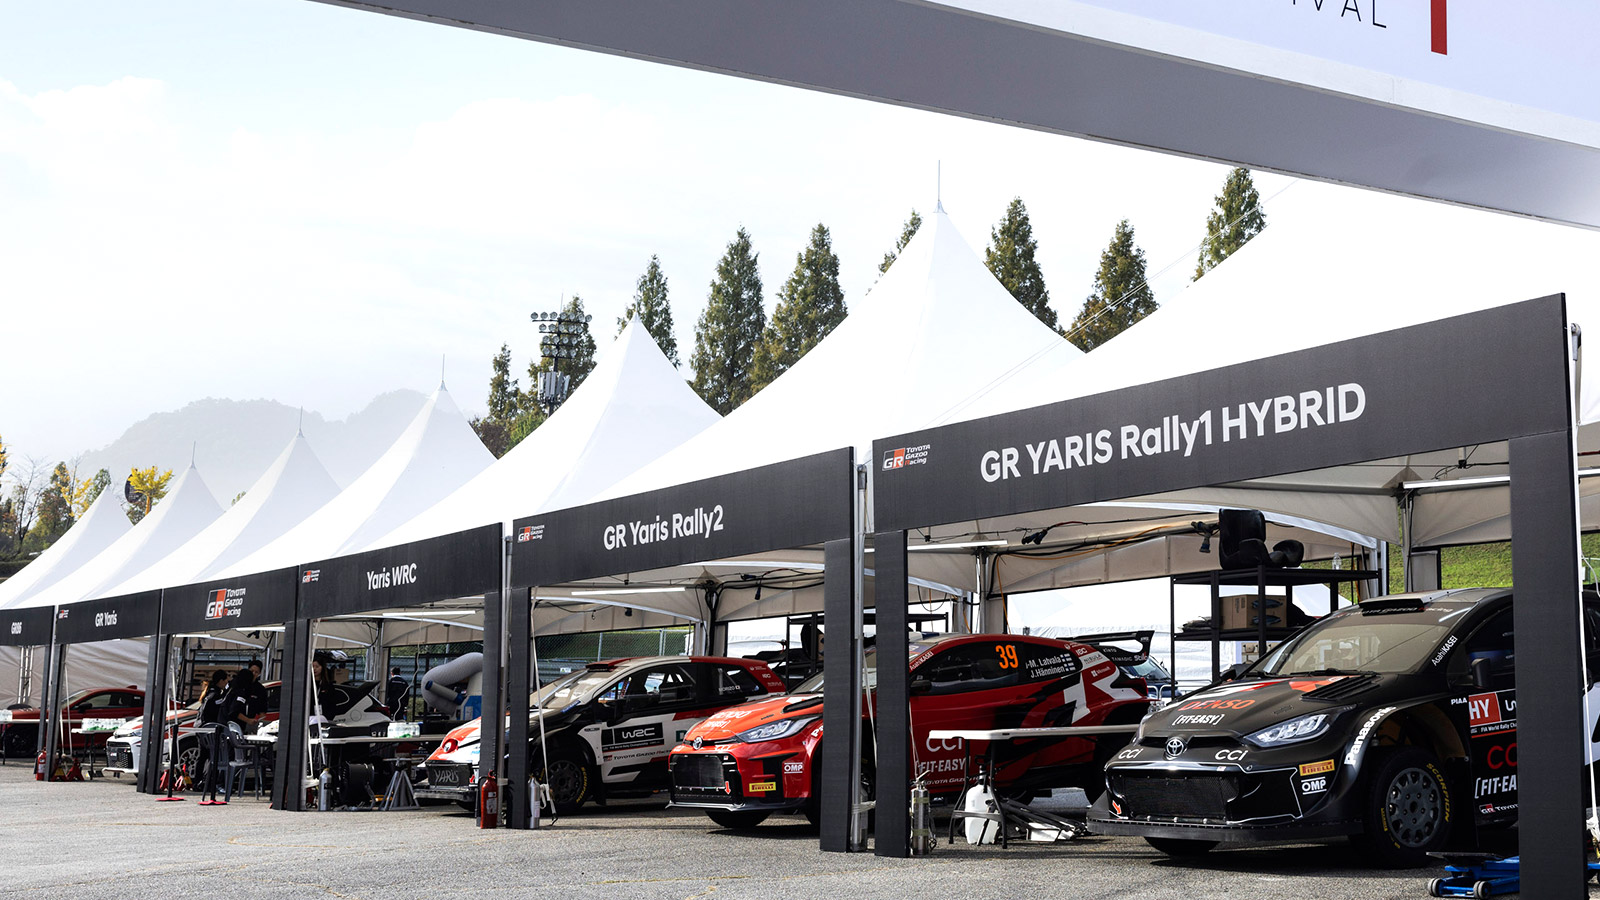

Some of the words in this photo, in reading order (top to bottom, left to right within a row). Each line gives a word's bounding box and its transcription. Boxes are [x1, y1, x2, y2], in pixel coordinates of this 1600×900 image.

[980, 447, 1021, 483] GR
[1025, 429, 1113, 475] YARIS
[1120, 410, 1213, 460] Rally1
[1221, 382, 1367, 443] HYBRID
[906, 444, 931, 453] TOYOTA
[905, 451, 928, 460] GAZOO
[883, 456, 904, 469] GR
[904, 458, 927, 466] Racing
[603, 524, 627, 550] GR
[629, 515, 668, 546] Yaris
[671, 504, 724, 539] Rally2
[518, 533, 530, 542] GR
[366, 567, 391, 590] Yaris
[392, 563, 417, 586] WRC
[226, 587, 246, 598] TOYOTA
[225, 598, 243, 607] GAZOO
[206, 601, 224, 618] GR
[223, 607, 241, 618] Racing
[95, 611, 104, 627] GR
[104, 610, 118, 626] Yaris
[995, 644, 1019, 669] 39
[1039, 656, 1062, 667] Latvala
[1178, 699, 1256, 711] DENSO
[1450, 697, 1468, 706] PIAA
[1468, 699, 1490, 720] HY
[621, 727, 656, 739] WRC
[784, 764, 803, 772] OMP
[1301, 779, 1327, 792] OMP
